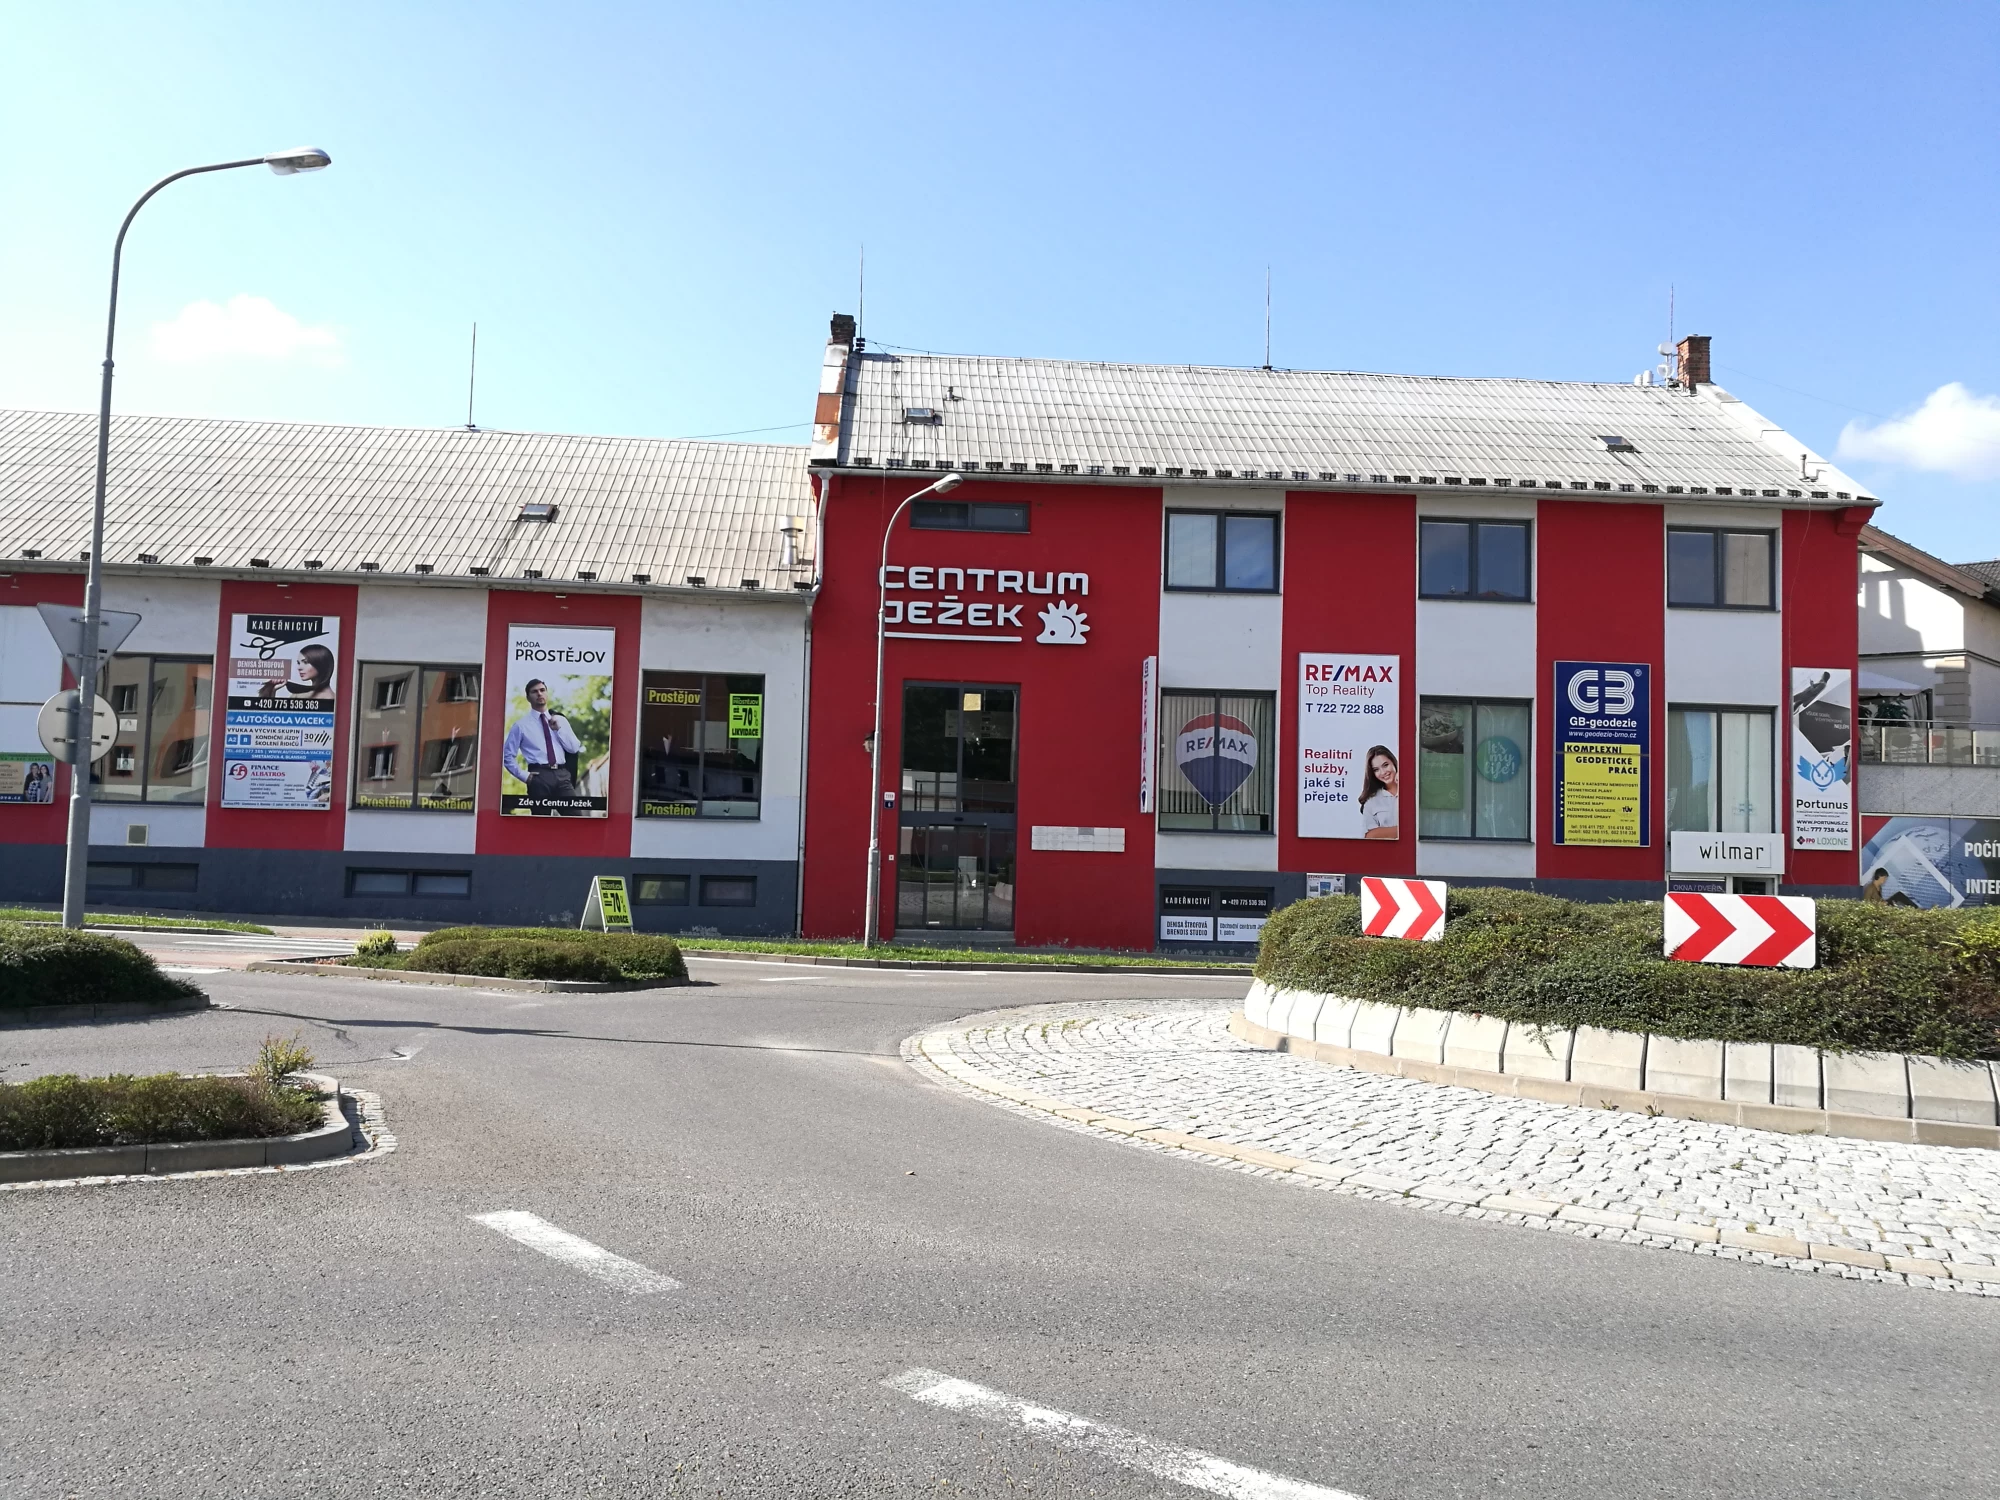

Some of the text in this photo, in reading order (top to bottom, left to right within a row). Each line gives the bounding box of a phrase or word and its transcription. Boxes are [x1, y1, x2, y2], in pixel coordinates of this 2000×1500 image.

[879, 566, 1089, 595] CENTRUM
[881, 595, 1024, 627] JEŽEK
[251, 619, 318, 632] KADEŘNICTVÍ
[515, 639, 541, 648] MÓDA
[515, 646, 606, 664] PROSTĚJOV
[237, 660, 257, 668] DENISA
[263, 669, 285, 677] STUDIO
[1304, 664, 1393, 683] RE/MAX
[648, 689, 701, 705] Prostějov
[1306, 683, 1375, 699] Top Reality
[1567, 669, 1635, 715] GB
[254, 699, 319, 710] +420 775 536 363
[1305, 702, 1385, 715] T 722 722 888
[235, 714, 325, 725] AUTOŠKOLA VACEK
[1569, 716, 1638, 729] GB-geodezie
[731, 728, 759, 737] LIKVIDACE
[1568, 730, 1637, 739] www.geodezie-brno.cz
[1487, 740, 1508, 754] It's
[1566, 745, 1622, 754] KOMPLEXNÍ
[1304, 748, 1353, 760] Realitní
[1489, 753, 1515, 767] my
[1575, 756, 1633, 765] GEODETICKÉ
[1304, 763, 1349, 776] služby,
[1484, 761, 1515, 779] life!
[1608, 766, 1638, 775] PRÁCE
[1304, 777, 1345, 789] jaké si
[1304, 790, 1349, 803] přejete
[518, 798, 533, 807] Zde
[542, 799, 568, 808] Centru
[569, 798, 593, 809] Ježek
[1622, 805, 1633, 813] TÜV
[1796, 798, 1849, 810] Portunus
[1816, 837, 1849, 846] LOXONE
[1699, 841, 1764, 860] wilmar
[1164, 896, 1211, 906] KADEŘNICTVÍ
[1184, 920, 1208, 929] ŠTROFOVÁ
